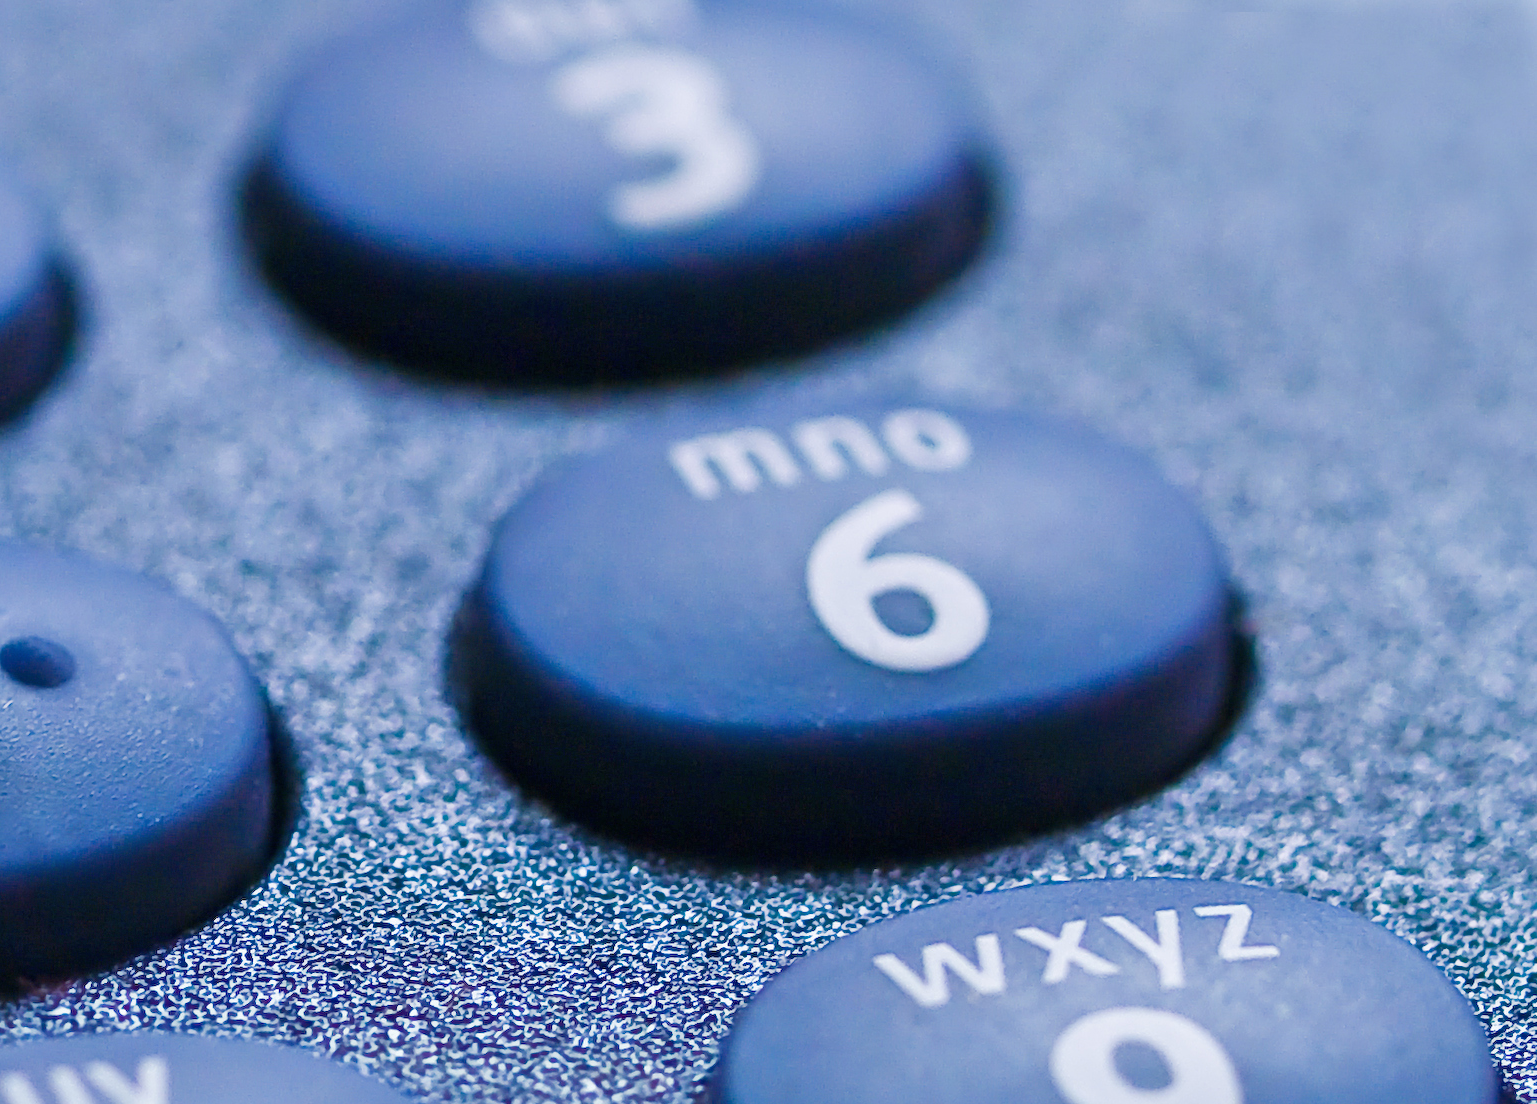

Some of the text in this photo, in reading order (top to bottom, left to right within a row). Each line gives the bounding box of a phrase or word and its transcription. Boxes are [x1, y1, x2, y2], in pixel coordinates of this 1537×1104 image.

[554, 41, 755, 226] 3
[670, 408, 972, 500] mno
[806, 488, 990, 670] 6
[873, 904, 1282, 1008] wxyz
